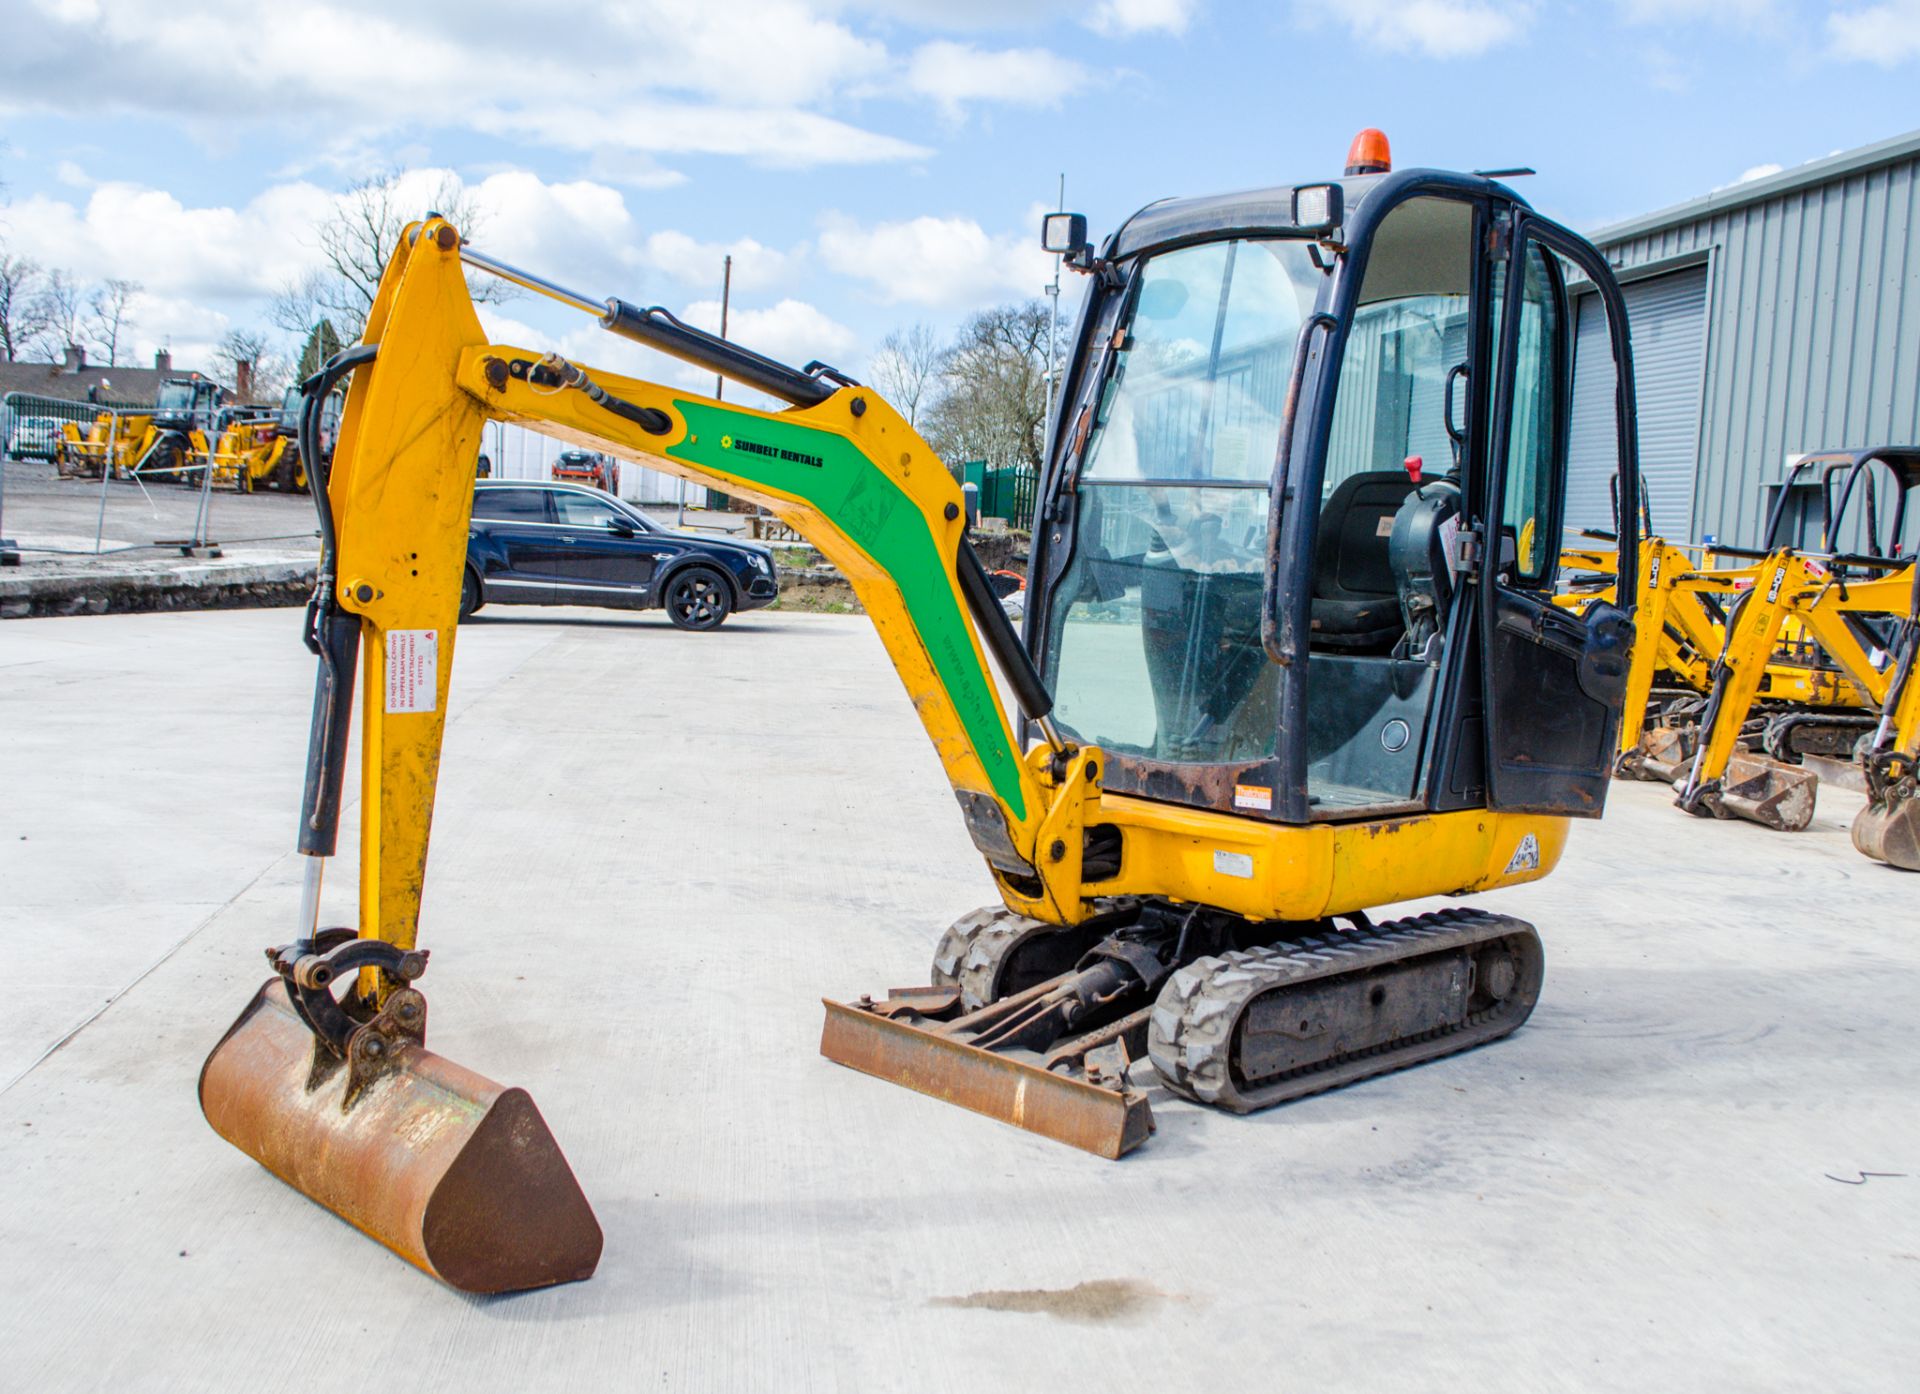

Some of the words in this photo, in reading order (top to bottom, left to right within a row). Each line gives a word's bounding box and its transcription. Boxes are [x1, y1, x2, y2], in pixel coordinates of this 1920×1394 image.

[734, 439, 779, 457] SUNBELT
[781, 449, 823, 468] RENTALS
[391, 697, 397, 709] DO
[400, 699, 406, 708] IN
